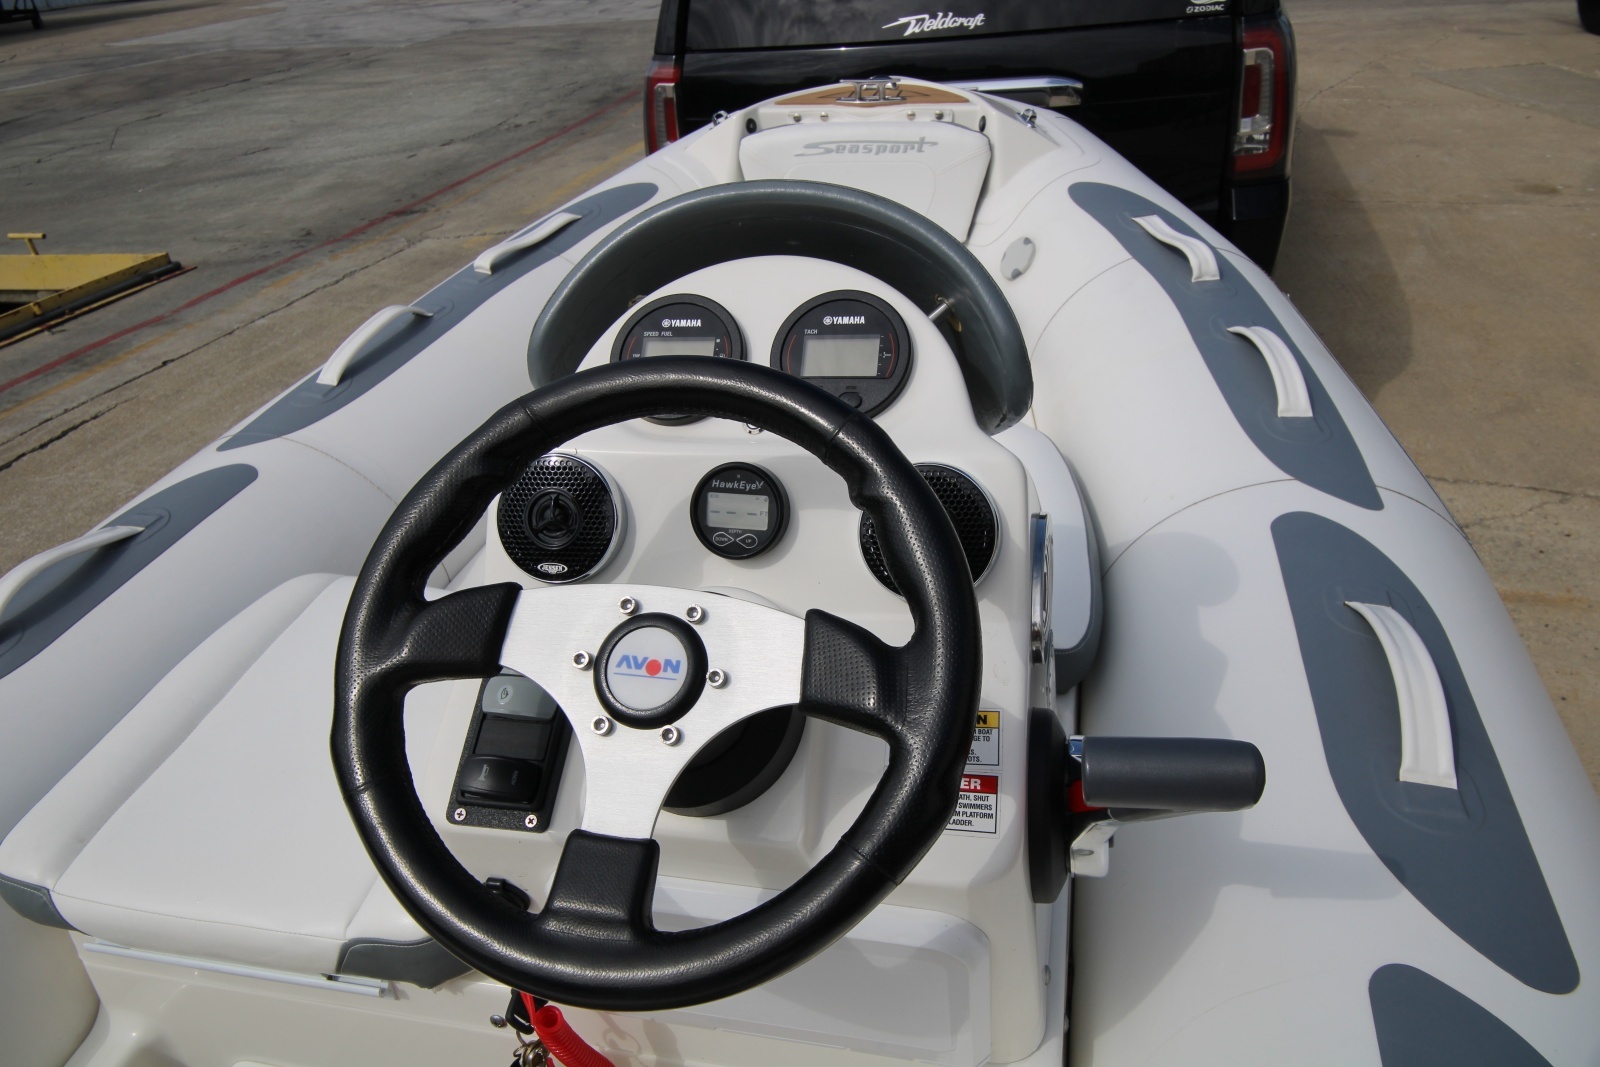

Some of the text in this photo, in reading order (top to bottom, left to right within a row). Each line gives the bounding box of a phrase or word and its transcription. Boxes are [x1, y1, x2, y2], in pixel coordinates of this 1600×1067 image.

[1194, 4, 1225, 12] ZODIAC
[881, 12, 986, 36] Weldcraft
[794, 136, 939, 156] Seasport
[671, 319, 701, 328] YAMAHA
[833, 316, 865, 325] YAMAHA
[615, 654, 681, 676] AVON
[967, 755, 982, 763] OTS.
[958, 793, 990, 802] ATH, SHUT
[958, 802, 993, 811] SWIMMERS
[961, 811, 994, 820] PLATFORM
